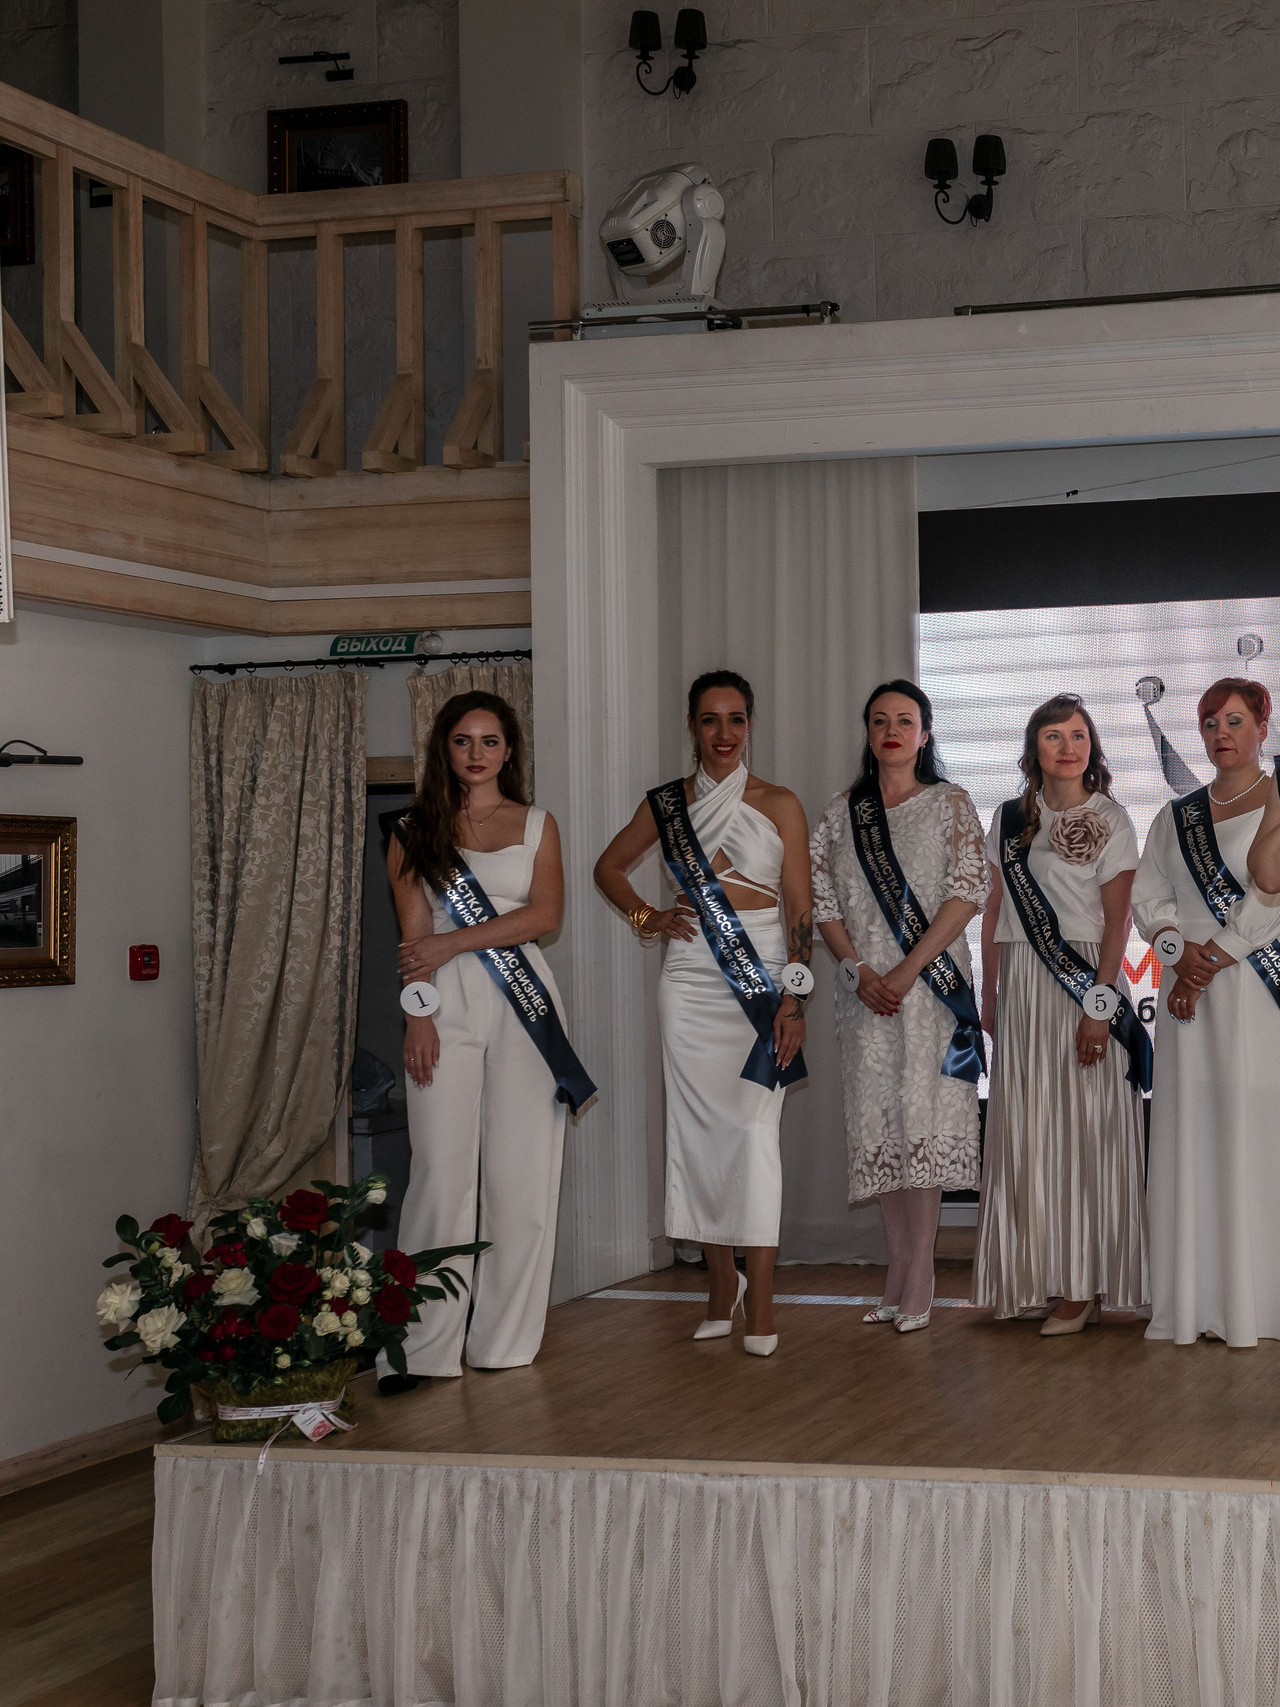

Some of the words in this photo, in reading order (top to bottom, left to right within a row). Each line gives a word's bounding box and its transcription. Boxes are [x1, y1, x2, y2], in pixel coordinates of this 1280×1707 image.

[336, 636, 409, 653] ВЫХОД
[870, 825, 901, 899] ФИНАЛИСТКА
[1186, 829, 1209, 885] НОВОСИБИРСК
[1195, 825, 1231, 898] ФИНАЛИСТКА
[450, 867, 483, 917] ЛИСТКА
[514, 967, 548, 1016] БИЗНЕС
[665, 822, 689, 881] НОВОСИБИРСК
[729, 961, 753, 1000] ОБЛАСТЬ
[673, 816, 711, 896] ФИНАЛИСТКА
[705, 896, 740, 948] МИССИС
[734, 948, 766, 995] БИЗНЕС
[859, 829, 884, 886] НОВОСИБИРСК
[926, 964, 949, 996] БЛАСТЬ
[1008, 867, 1039, 928] НОВОСИБИРСК
[1035, 934, 1086, 997] НОВОСИБИРСКАЯ
[1014, 863, 1051, 941] ФИНАЛИСТКА
[1048, 939, 1087, 982] МИССИС
[412, 990, 430, 1009] 1
[510, 982, 538, 1023] ОБЛАСТЬ
[791, 971, 805, 987] 3
[844, 967, 856, 982] 4
[1095, 993, 1107, 1012] 5
